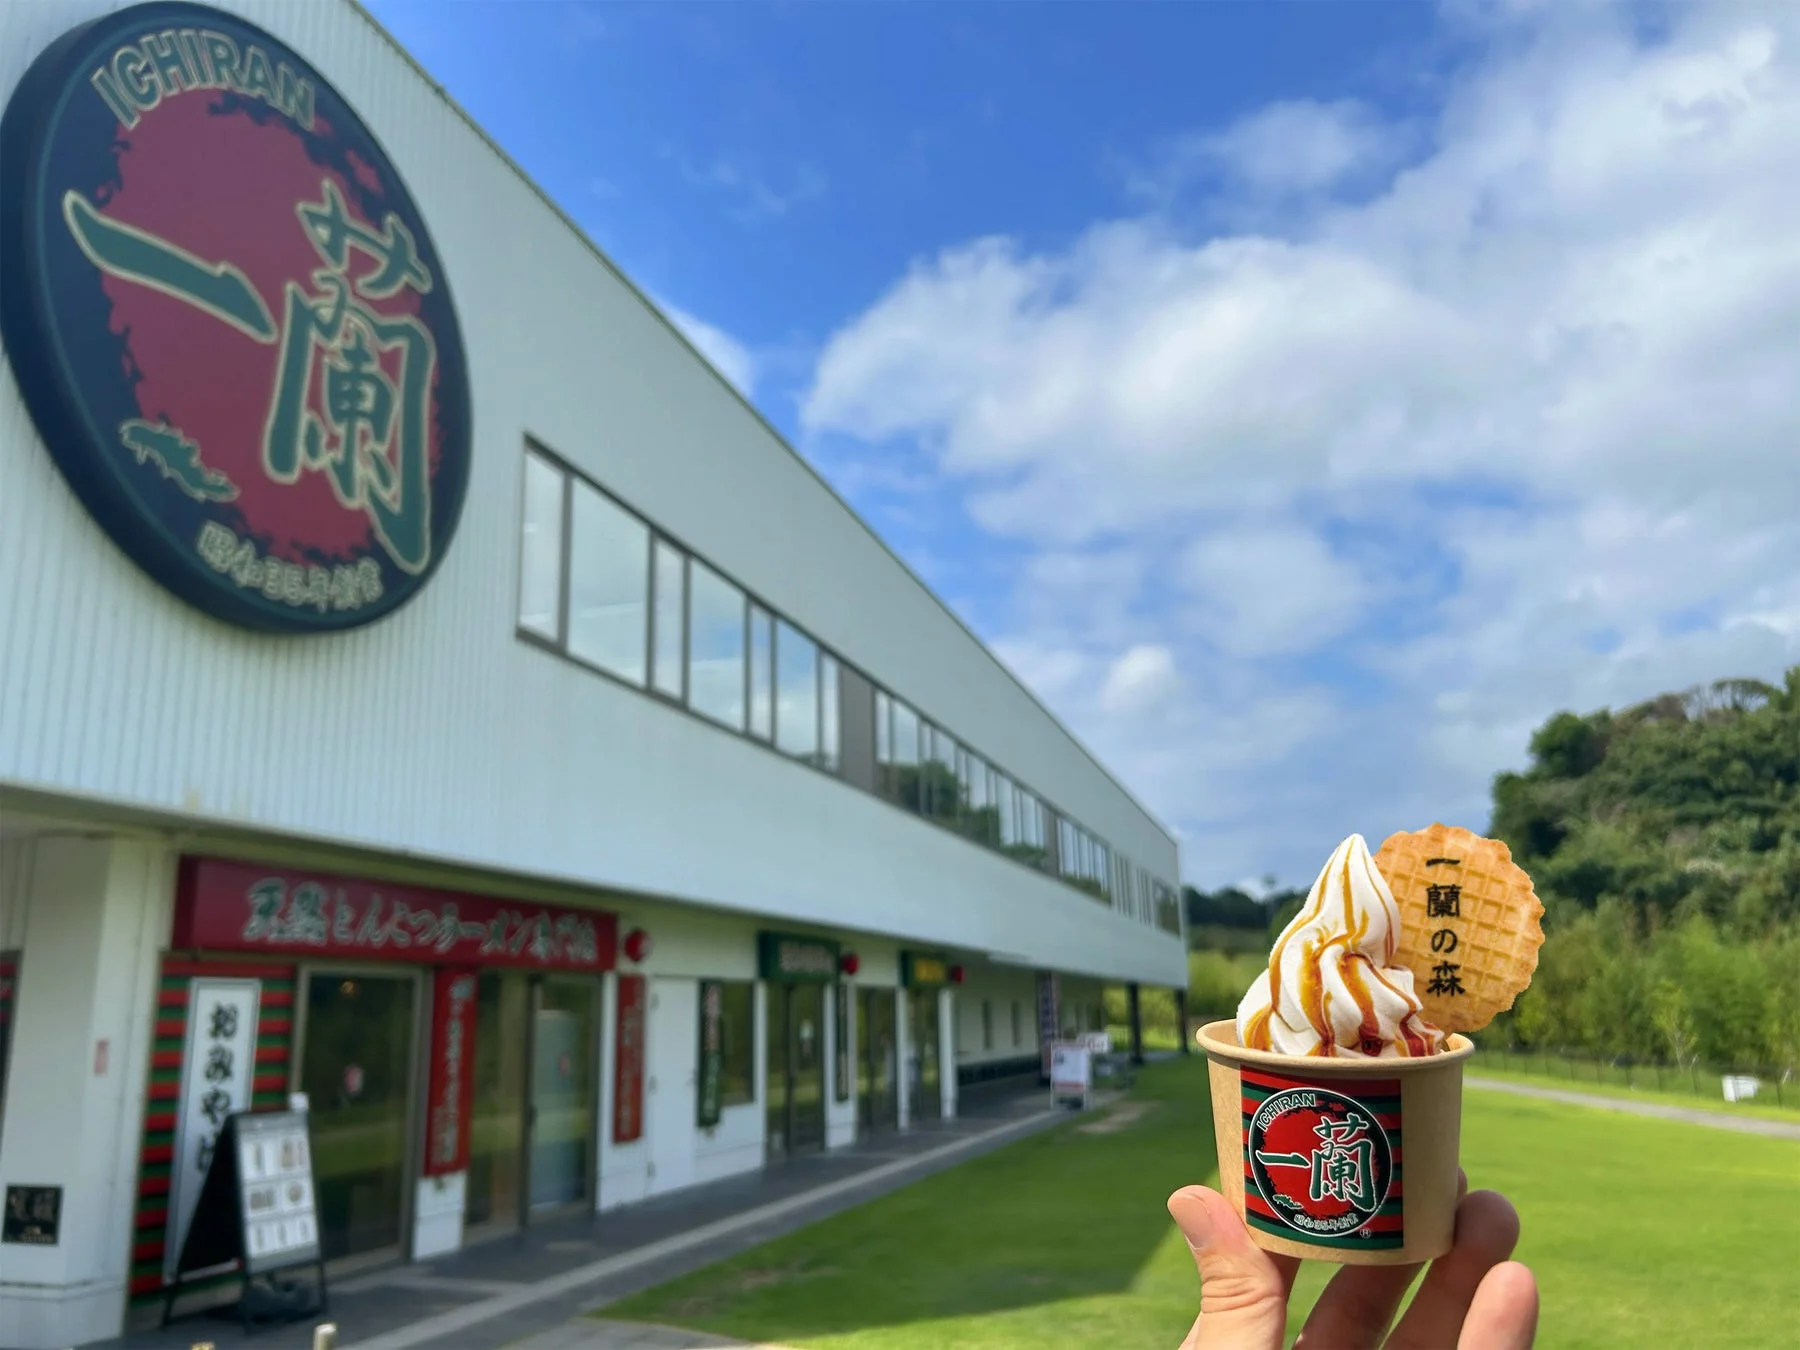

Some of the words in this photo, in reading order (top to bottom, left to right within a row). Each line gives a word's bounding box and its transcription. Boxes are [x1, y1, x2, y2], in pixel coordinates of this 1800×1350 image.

[91, 29, 315, 131] ICHIRAN
[62, 178, 434, 574] 一蘭
[1426, 858, 1466, 997] 一蘭の森
[1256, 1093, 1316, 1132] ICHIRAN
[1256, 1112, 1377, 1212] 一蘭
